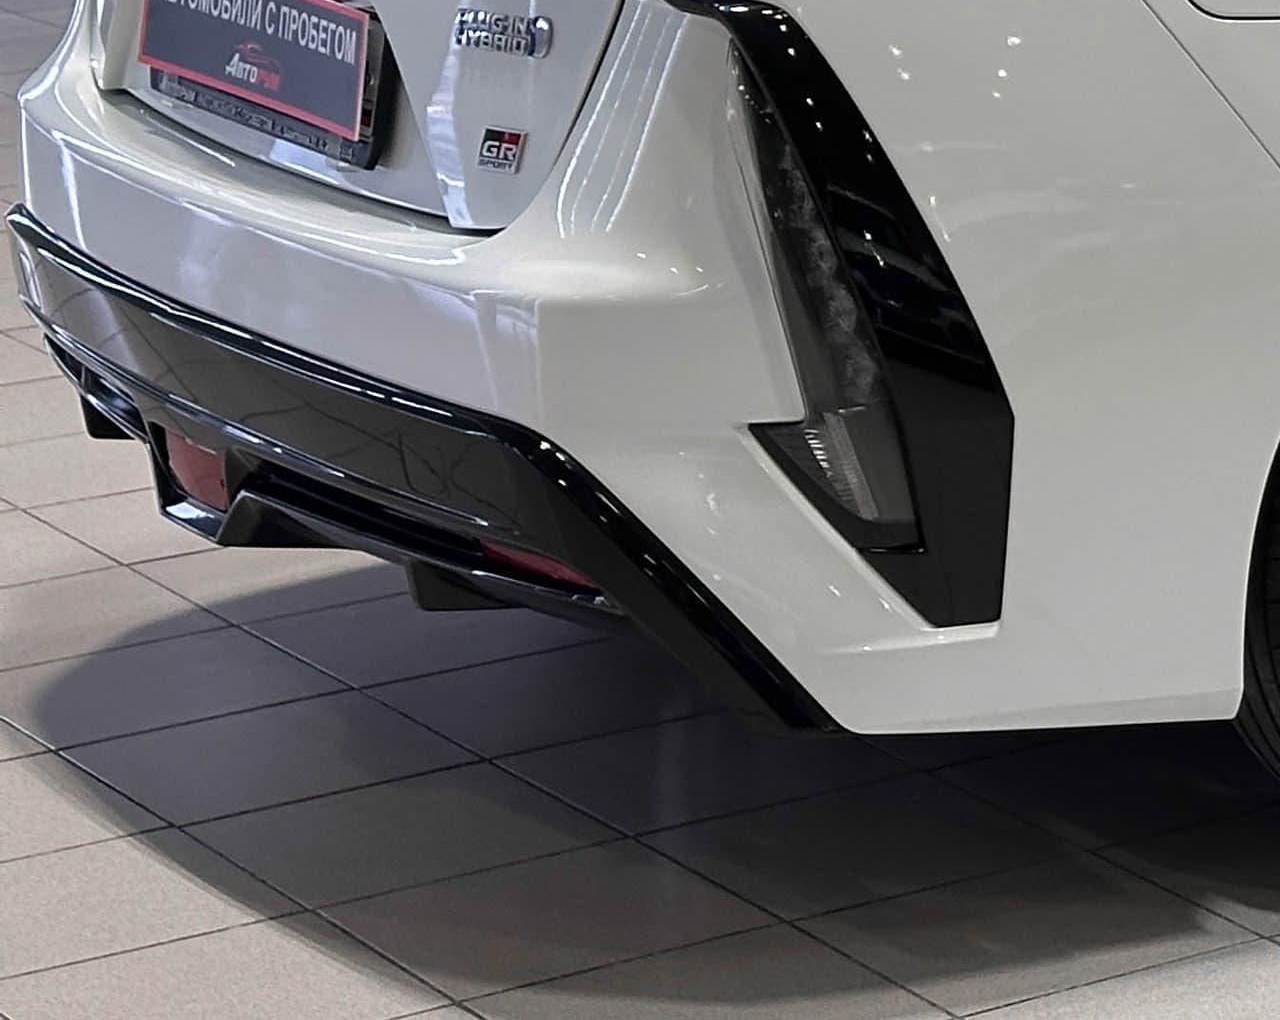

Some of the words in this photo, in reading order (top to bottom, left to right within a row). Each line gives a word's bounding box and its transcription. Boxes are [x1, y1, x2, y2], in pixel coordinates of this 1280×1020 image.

[265, 1, 276, 34] С
[278, 4, 357, 65] ПРОБЕГОМ
[481, 140, 517, 161] GR
